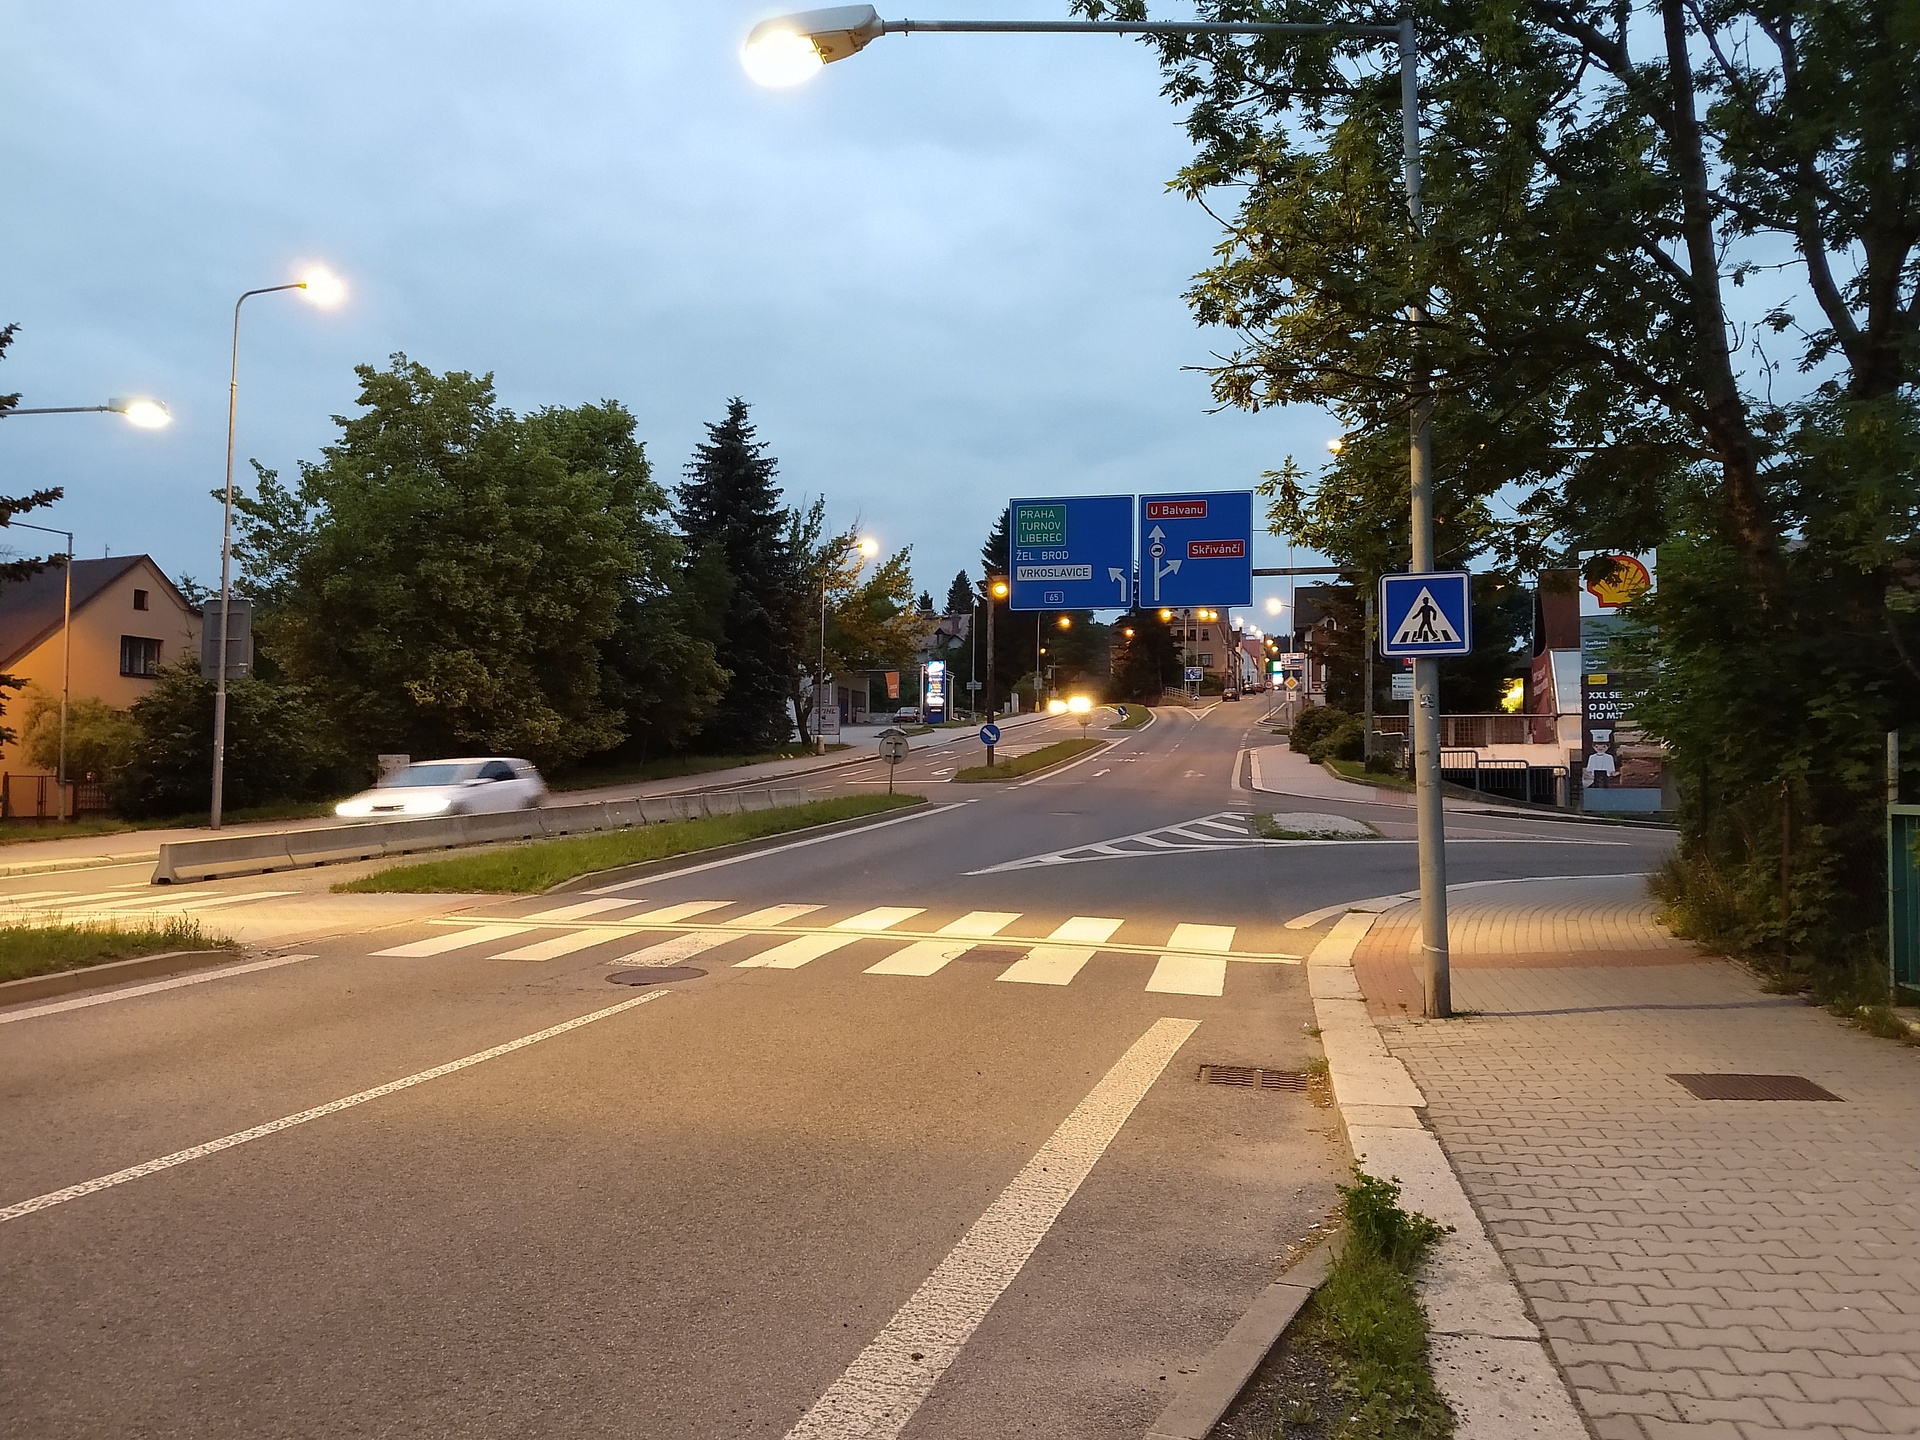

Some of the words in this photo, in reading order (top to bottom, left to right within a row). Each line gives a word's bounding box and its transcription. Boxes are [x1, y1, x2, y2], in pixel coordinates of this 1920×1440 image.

[1020, 509, 1056, 519] PRAHA
[1150, 506, 1158, 515] U
[1162, 505, 1203, 515] Balvanu
[1021, 521, 1061, 531] TURNOV
[1020, 533, 1062, 543] LIBEREC
[1191, 543, 1241, 554] Skřivánčí
[1041, 551, 1069, 560] BROD
[1020, 568, 1089, 578] VRKOSLAVICE
[1588, 691, 1607, 699] XXL
[1588, 703, 1597, 711] O
[1588, 712, 1604, 720] HO
